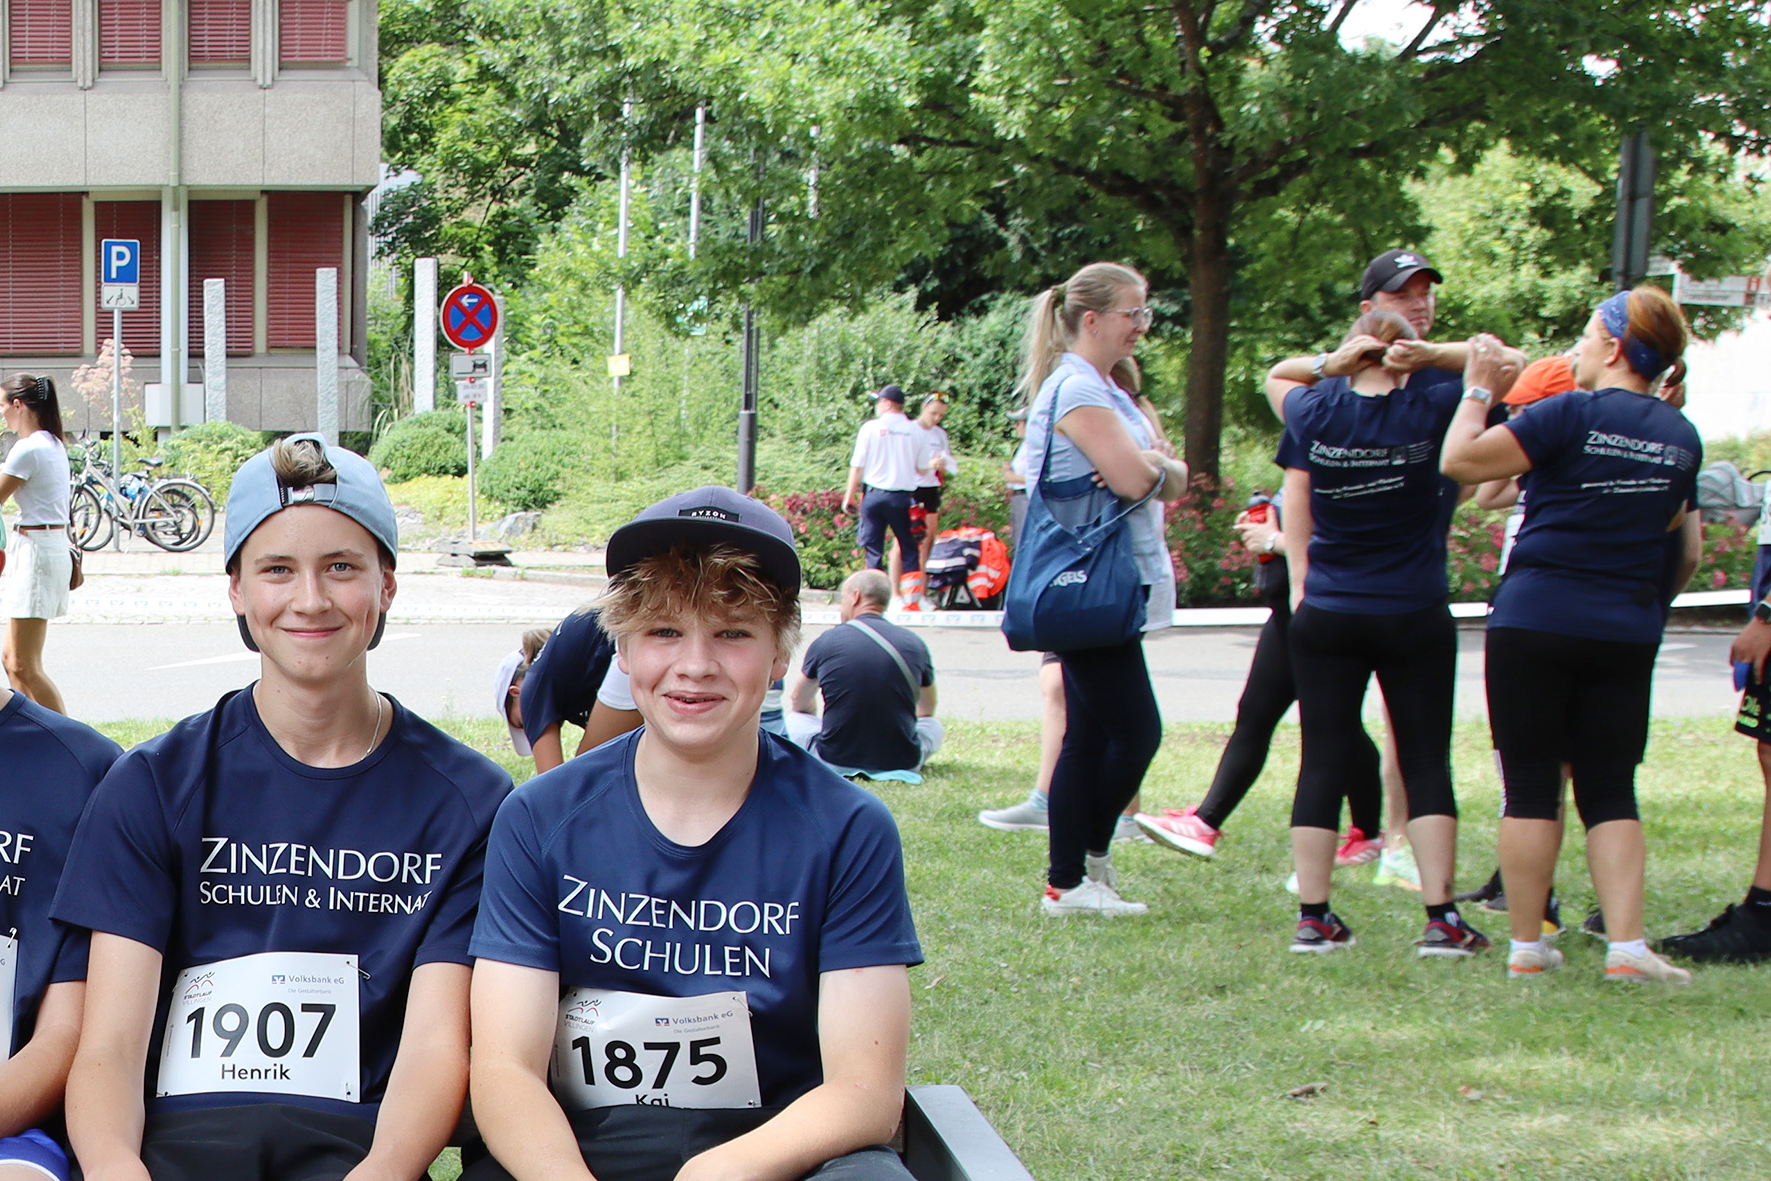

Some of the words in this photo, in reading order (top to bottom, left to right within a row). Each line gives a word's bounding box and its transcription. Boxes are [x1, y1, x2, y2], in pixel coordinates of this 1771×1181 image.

[111, 245, 131, 279] P
[1310, 440, 1387, 459] ZINZENDORF
[1586, 431, 1664, 454] ZINZENDORF
[691, 510, 726, 519] RYZON
[200, 837, 442, 884] ZINZENDORF
[199, 881, 298, 905] SCHULEN
[304, 889, 321, 909] &
[328, 887, 432, 914] INTERNAT
[557, 874, 800, 935] ZINZENDORF
[590, 928, 771, 979] SCHULEN
[288, 975, 332, 984] Volksbank
[334, 977, 345, 985] eG
[186, 1002, 336, 1058] 1907
[672, 1014, 719, 1025] Volksbank
[720, 1010, 734, 1018] eG
[221, 1063, 291, 1080] Henrik
[572, 1036, 728, 1090] 1875
